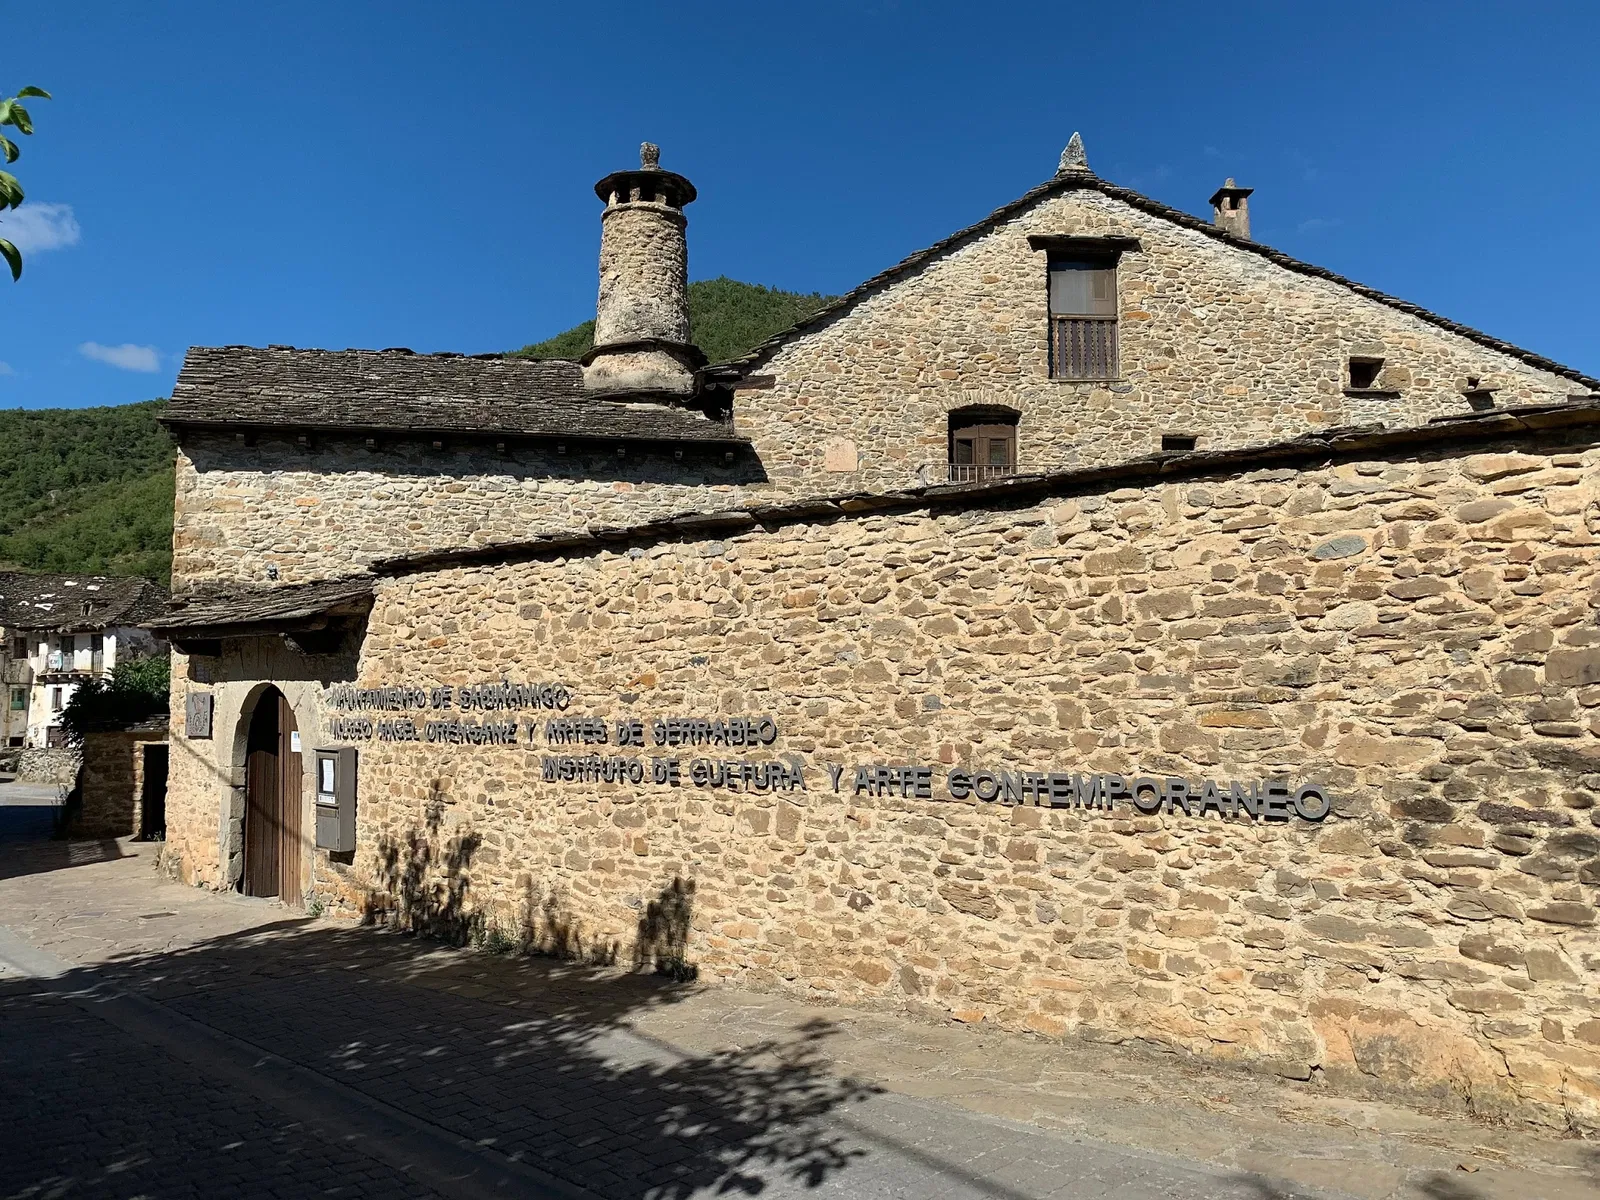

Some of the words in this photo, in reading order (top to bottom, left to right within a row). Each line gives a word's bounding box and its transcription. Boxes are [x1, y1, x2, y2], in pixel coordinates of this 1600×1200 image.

[430, 685, 452, 708] DE
[329, 718, 373, 740] MUSEO
[377, 718, 420, 741] ANGEL
[424, 719, 517, 743] ORENSANZ
[526, 721, 536, 742] Y
[545, 717, 606, 744] ARTES
[616, 718, 644, 745] DE
[651, 716, 777, 746] SERRABLO
[542, 755, 642, 784] INSTITUTO
[652, 757, 680, 785] DE
[689, 758, 805, 790] CULTURA
[827, 762, 843, 792] Y
[853, 765, 931, 797] ARTE
[947, 767, 1331, 822] CONTEMPORANEO
